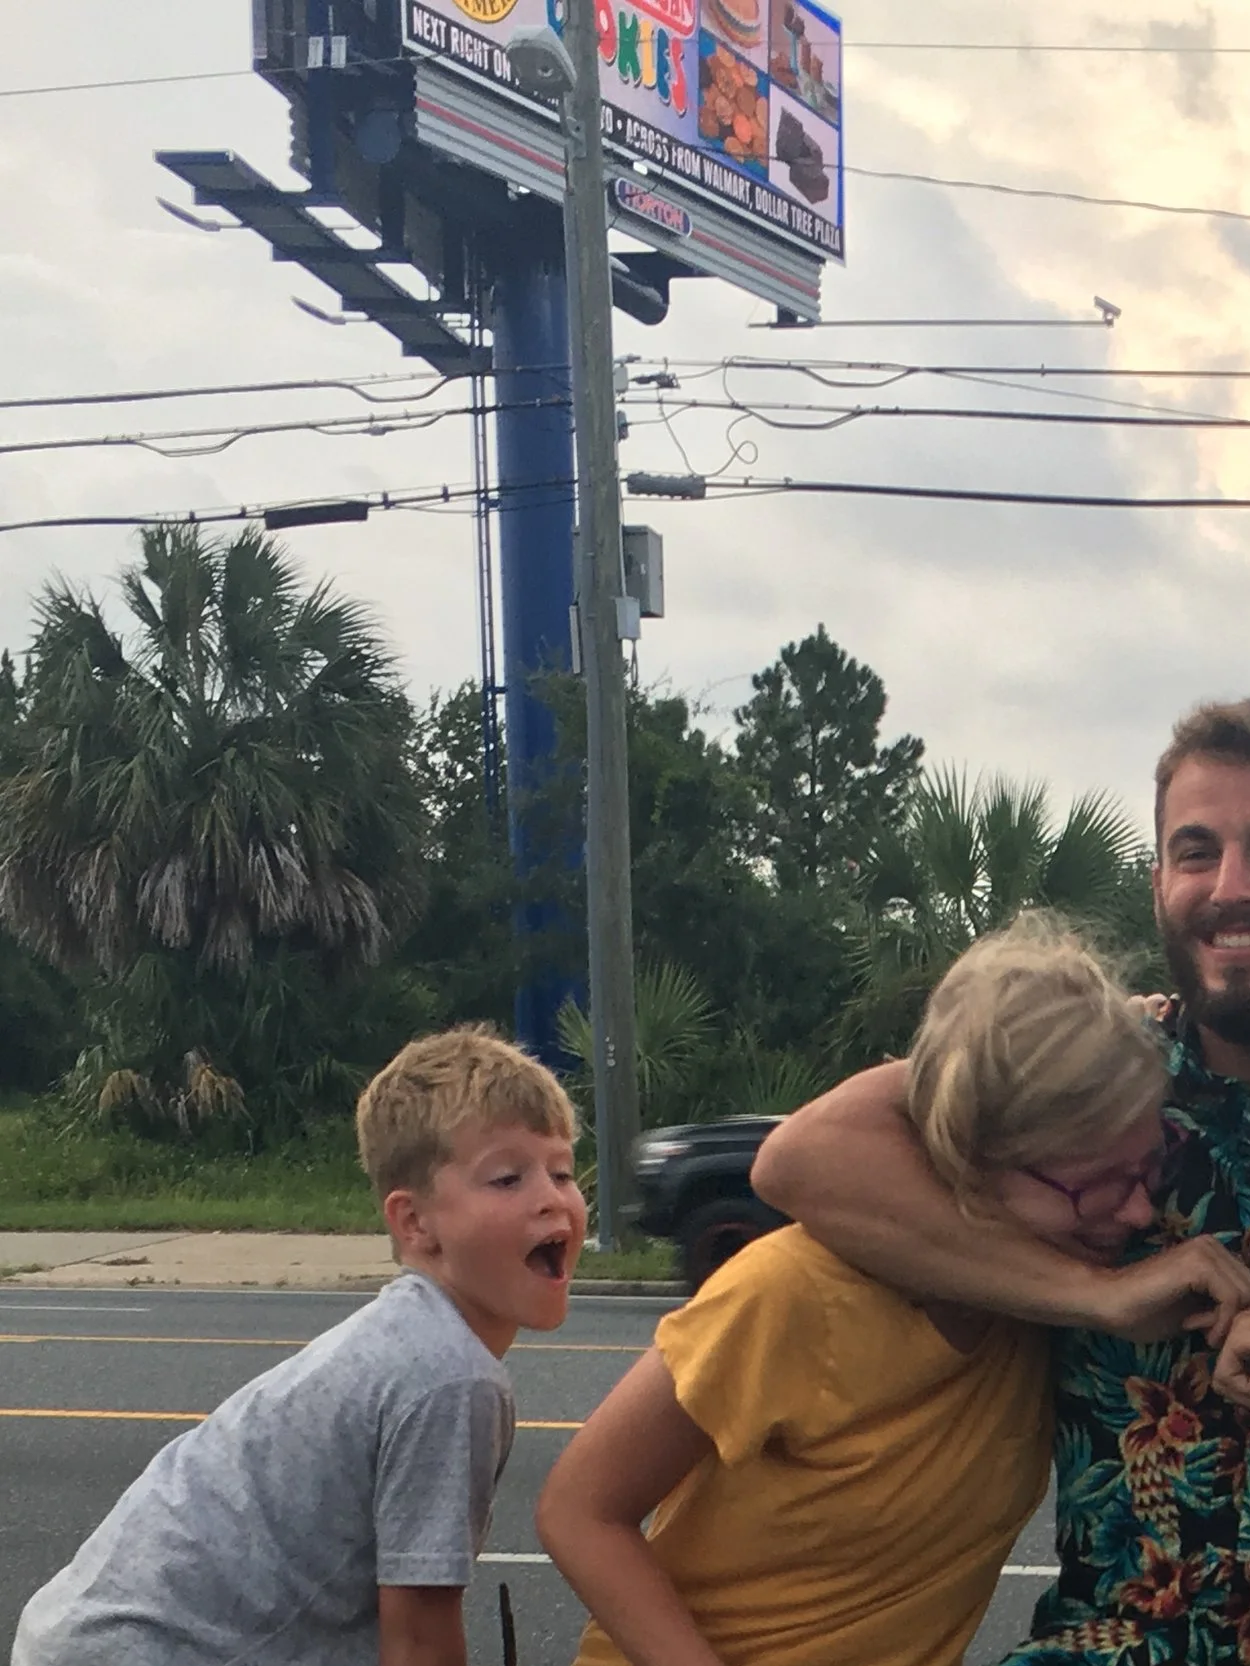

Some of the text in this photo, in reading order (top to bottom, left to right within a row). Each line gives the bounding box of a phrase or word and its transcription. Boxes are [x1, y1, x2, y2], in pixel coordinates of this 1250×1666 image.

[413, 6, 512, 82] NEXT RIGHT ON
[626, 118, 669, 163] ACROSS
[672, 144, 701, 180] FROM
[703, 158, 753, 210] WALMART,
[755, 186, 789, 225] DOLLAR
[791, 205, 813, 238] TREE
[814, 218, 841, 251] PLAZA
